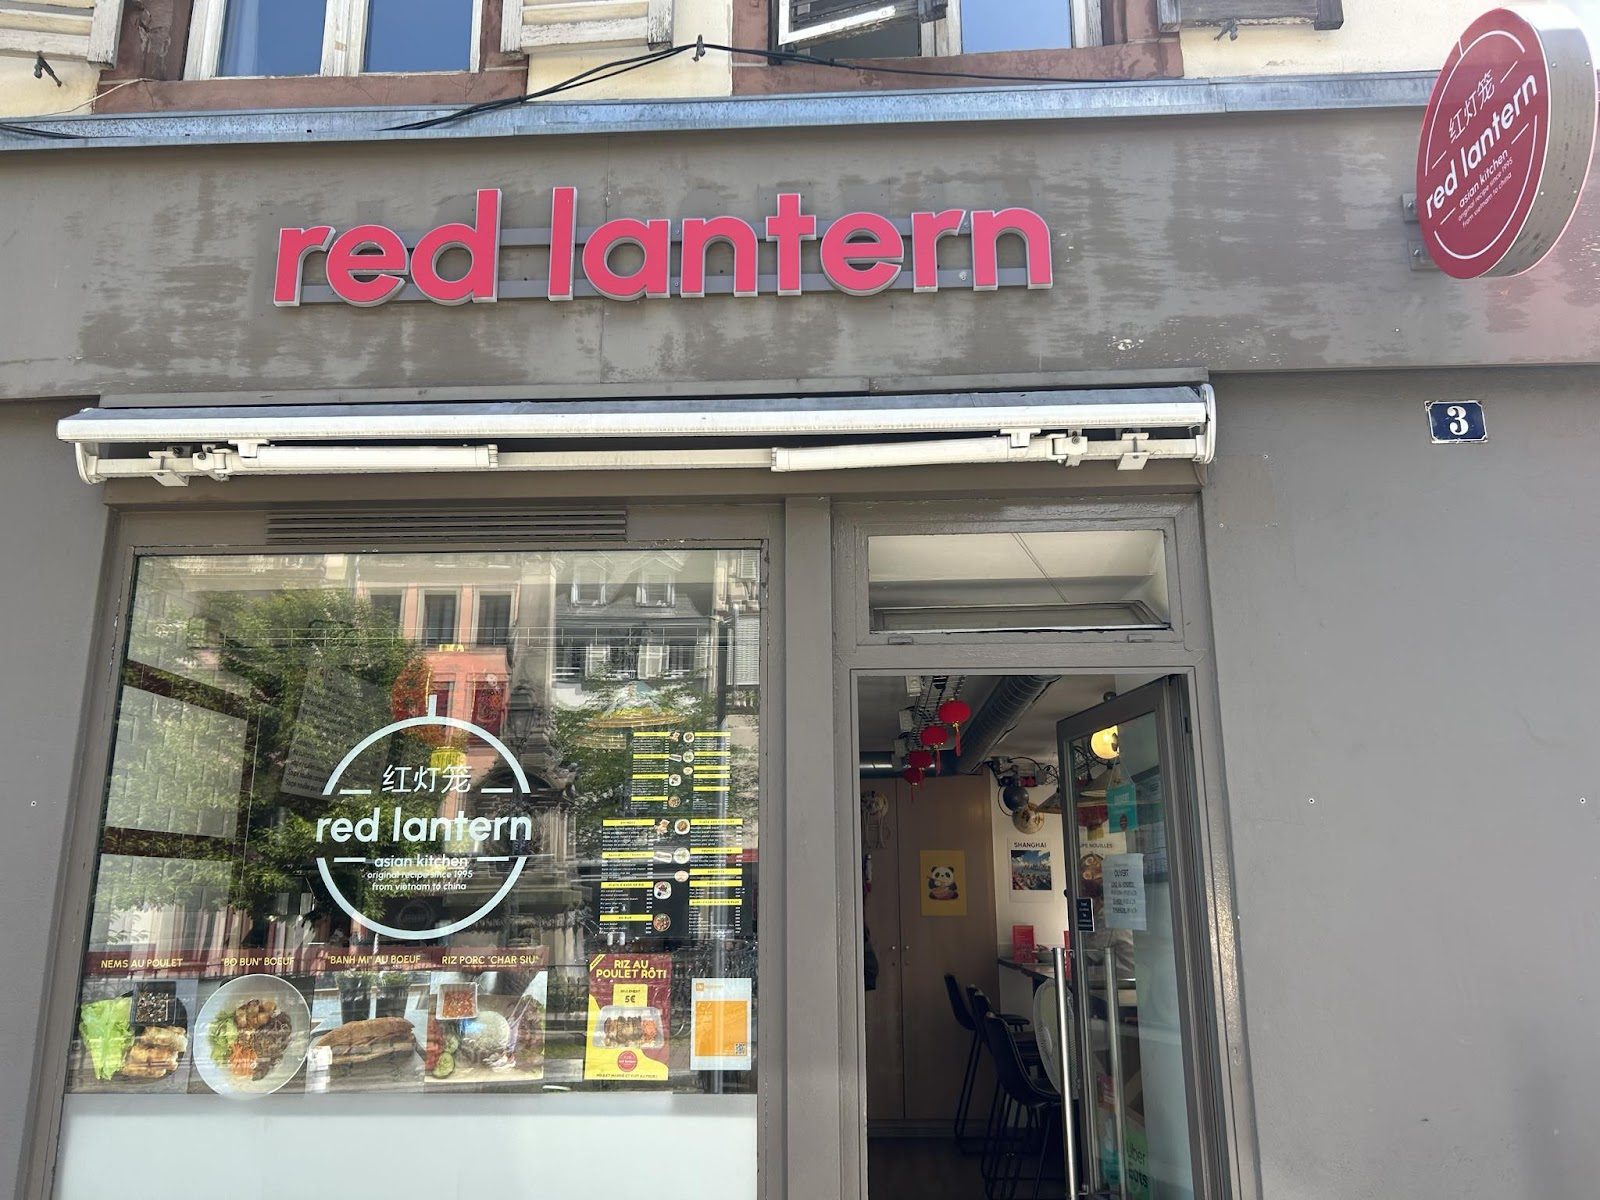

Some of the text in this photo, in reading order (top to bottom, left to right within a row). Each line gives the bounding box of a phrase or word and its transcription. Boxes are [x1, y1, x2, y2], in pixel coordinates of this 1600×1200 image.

[1448, 68, 1495, 144] 红灯笼
[1425, 74, 1538, 219] red lantern
[1459, 149, 1509, 208] asian kitchen
[1459, 199, 1475, 222] original
[1489, 171, 1502, 187] since
[1501, 156, 1513, 173] 1995
[1462, 214, 1474, 228] from
[1474, 193, 1493, 216] vietnam
[1498, 172, 1512, 189] china
[273, 186, 1053, 307] red lantern
[447, 405, 469, 436] 3
[382, 764, 473, 794] 红灯笼
[315, 807, 532, 843] red lantern
[374, 853, 468, 868] asian kitchen
[367, 870, 474, 881] original recipe since 1995
[371, 882, 467, 891] from vietnam to china
[100, 958, 184, 969] NEMS AU POULET
[264, 956, 295, 966] BOEUF
[327, 955, 355, 965] "BANH
[374, 955, 389, 965] AU
[390, 954, 422, 964] BOEUF
[441, 955, 458, 965] RIZ
[459, 955, 485, 965] PORC
[614, 959, 649, 969] RIZ AU
[596, 966, 667, 979] POULET RÔTI
[624, 994, 636, 1003] 5€
